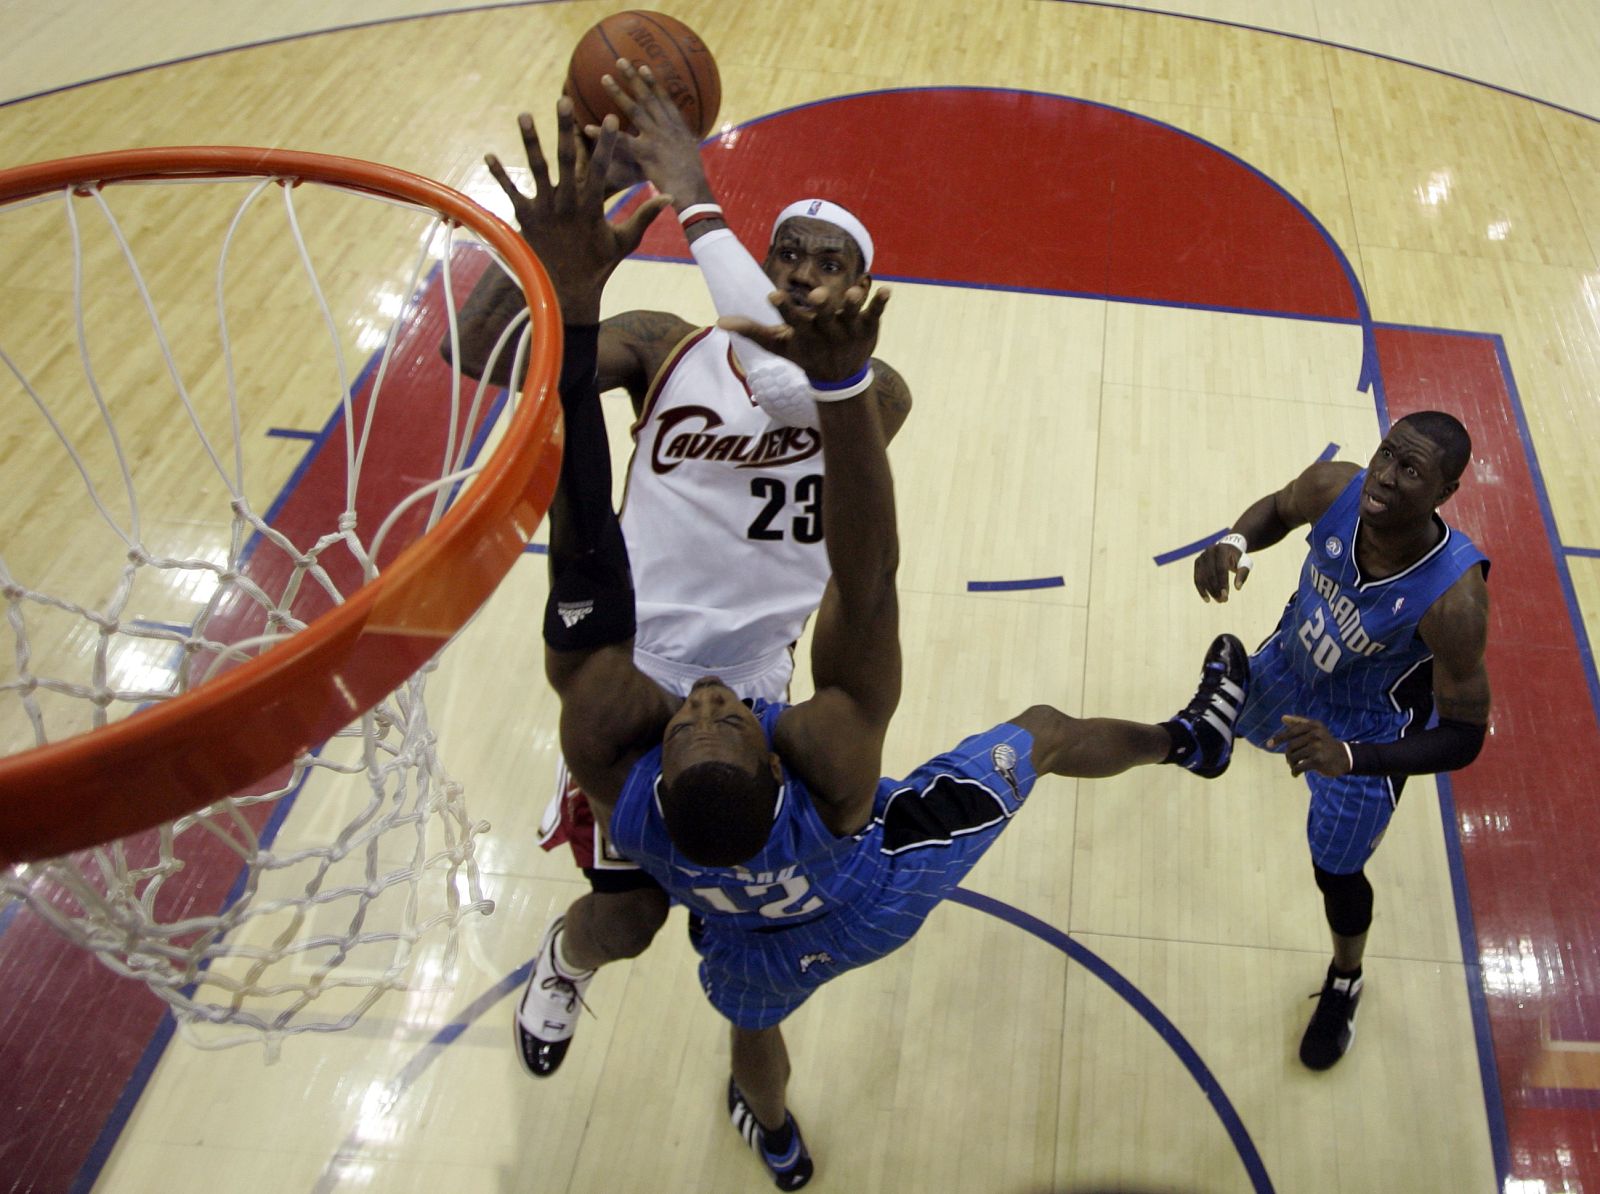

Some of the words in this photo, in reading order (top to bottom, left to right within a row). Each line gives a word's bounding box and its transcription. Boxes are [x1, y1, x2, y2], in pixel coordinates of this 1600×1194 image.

[747, 474, 824, 544] 23
[1298, 606, 1342, 674] 20
[692, 875, 824, 919] 12
